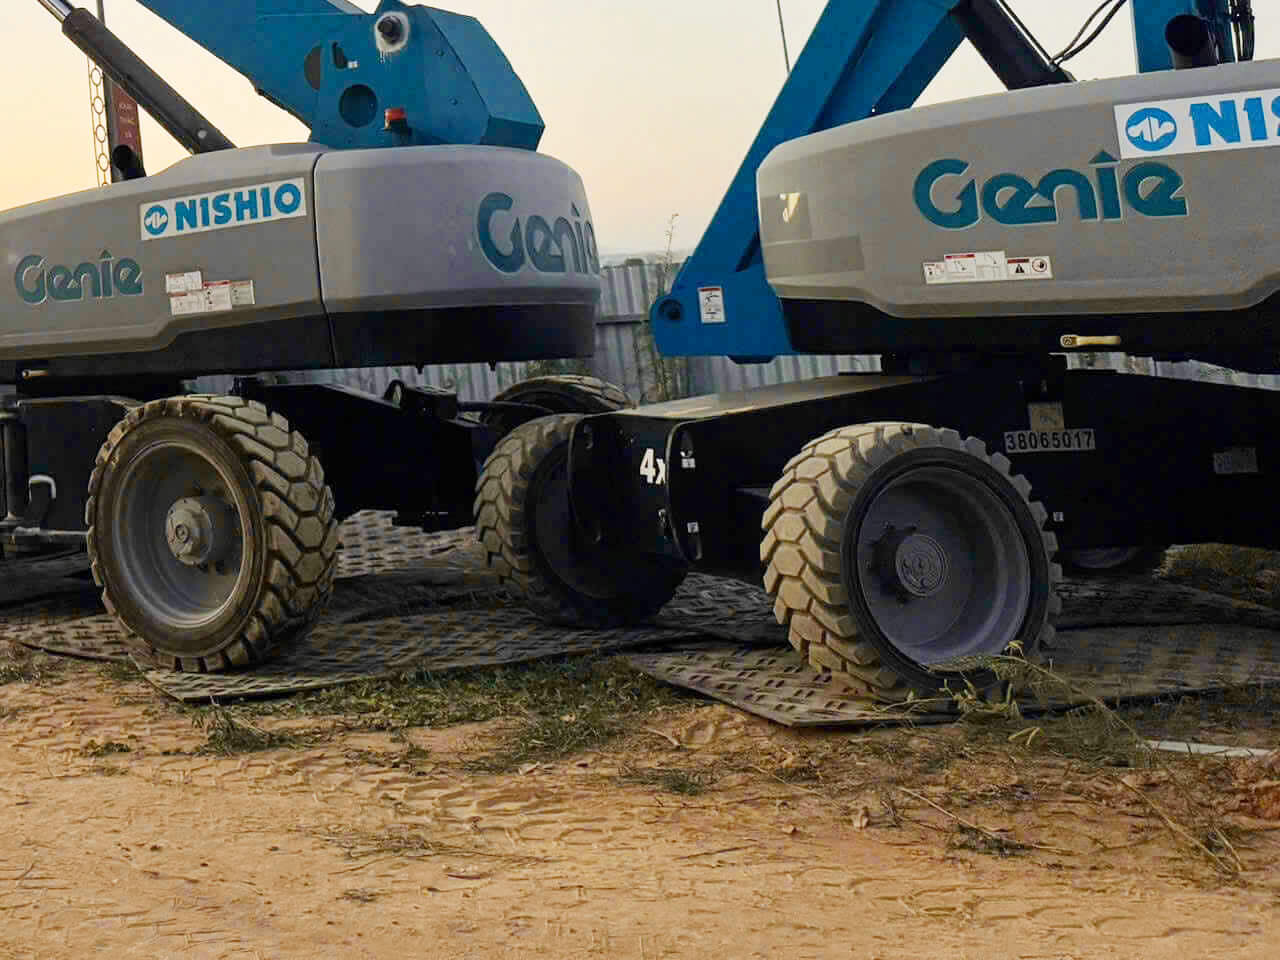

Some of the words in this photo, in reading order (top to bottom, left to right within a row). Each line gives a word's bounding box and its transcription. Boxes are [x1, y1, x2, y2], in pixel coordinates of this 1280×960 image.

[1189, 96, 1280, 147] NI
[173, 182, 302, 233] NISHIO
[913, 150, 1188, 230] Genie
[14, 249, 144, 304] Genie
[1005, 431, 1093, 450] 38065017
